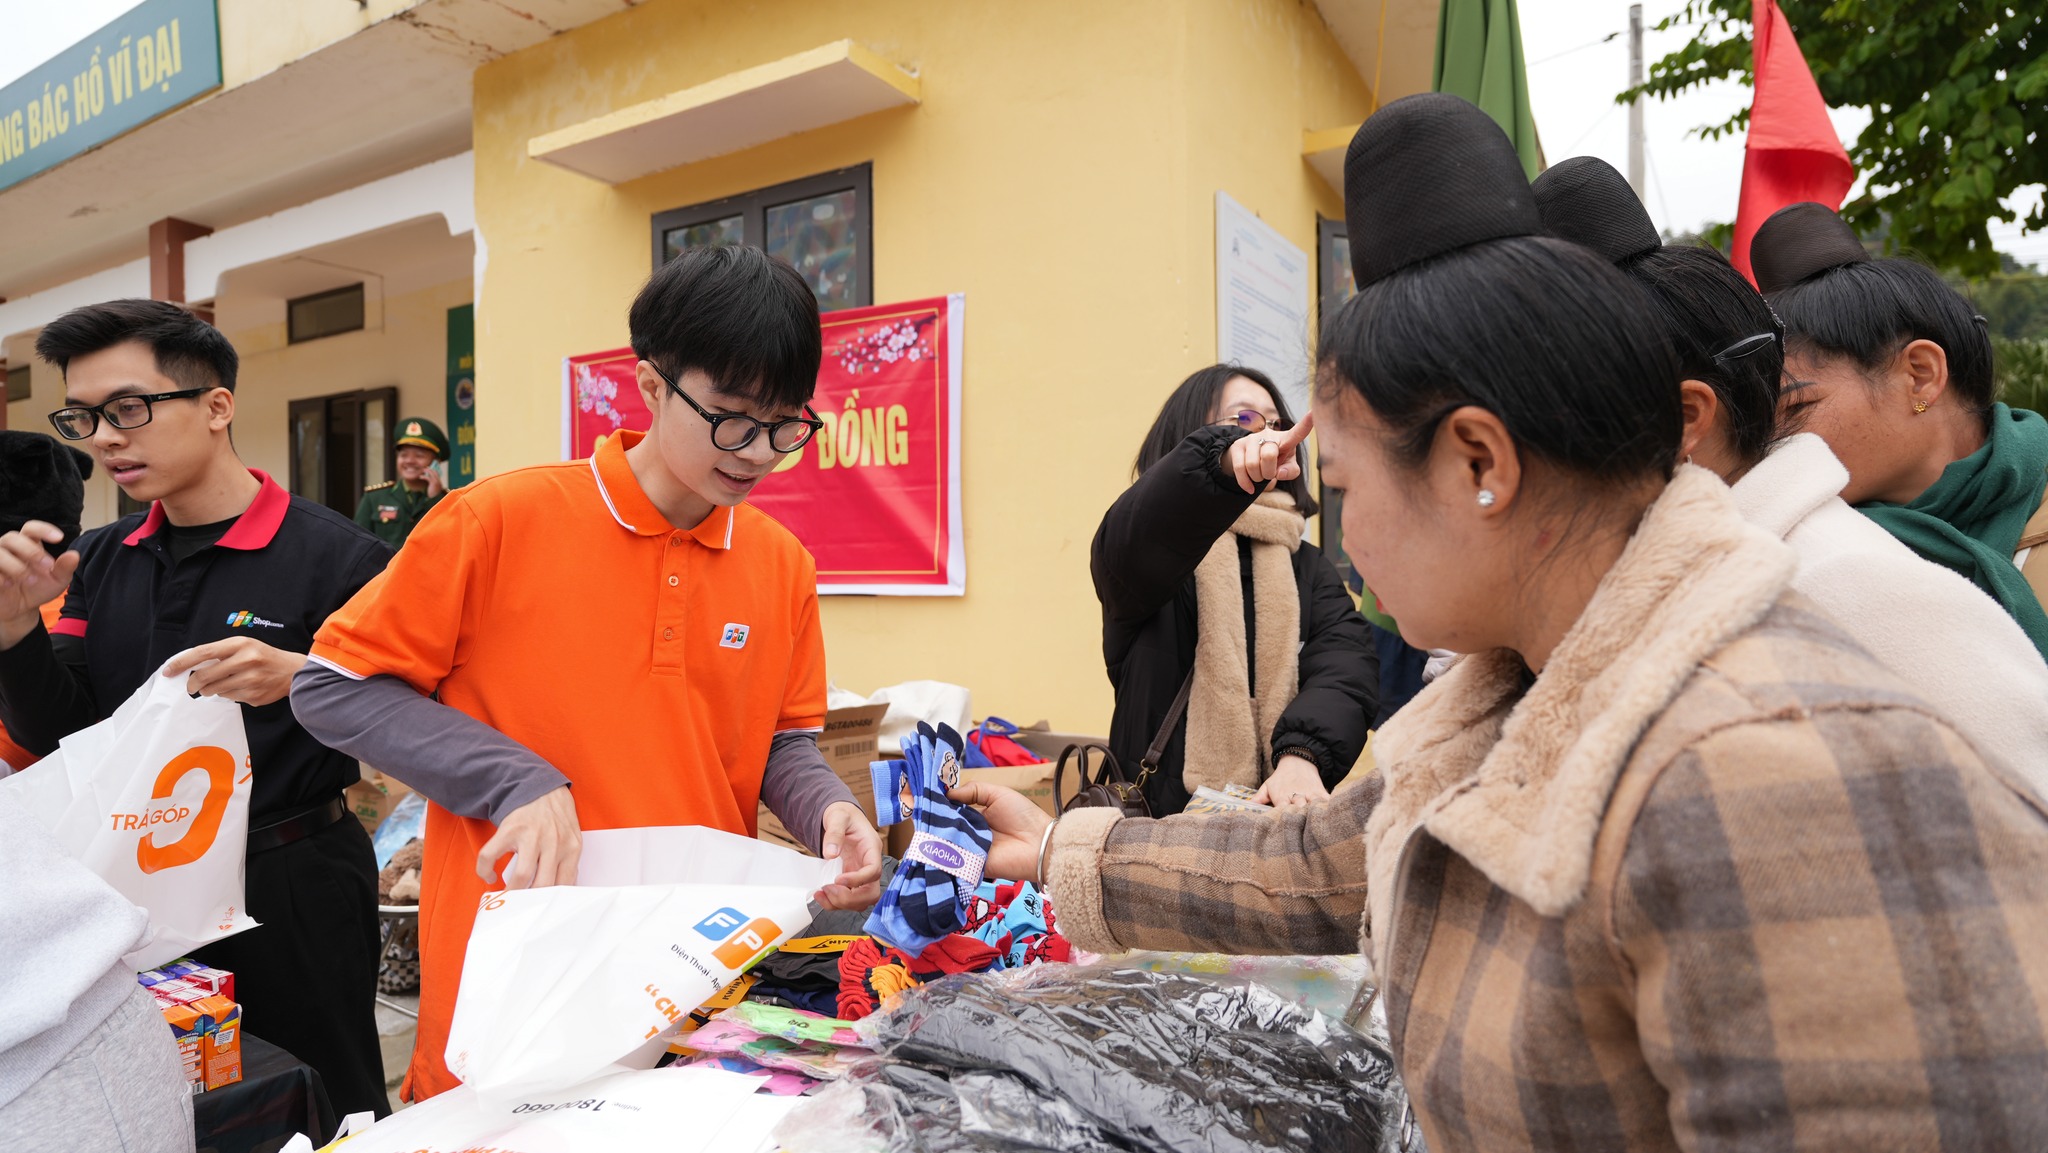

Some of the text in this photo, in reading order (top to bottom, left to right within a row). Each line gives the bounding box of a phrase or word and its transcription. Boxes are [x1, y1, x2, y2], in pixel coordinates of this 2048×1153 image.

[27, 81, 70, 150] BÁC
[73, 45, 105, 126] HỒ
[108, 35, 133, 106] VĨ
[137, 17, 182, 93] ĐẠI
[816, 388, 909, 470] ĐỒNG
[110, 803, 191, 832] TRẢ GÓP
[922, 843, 962, 867] XIAOHALI
[670, 943, 690, 962] Điện
[689, 955, 712, 978] Thoại
